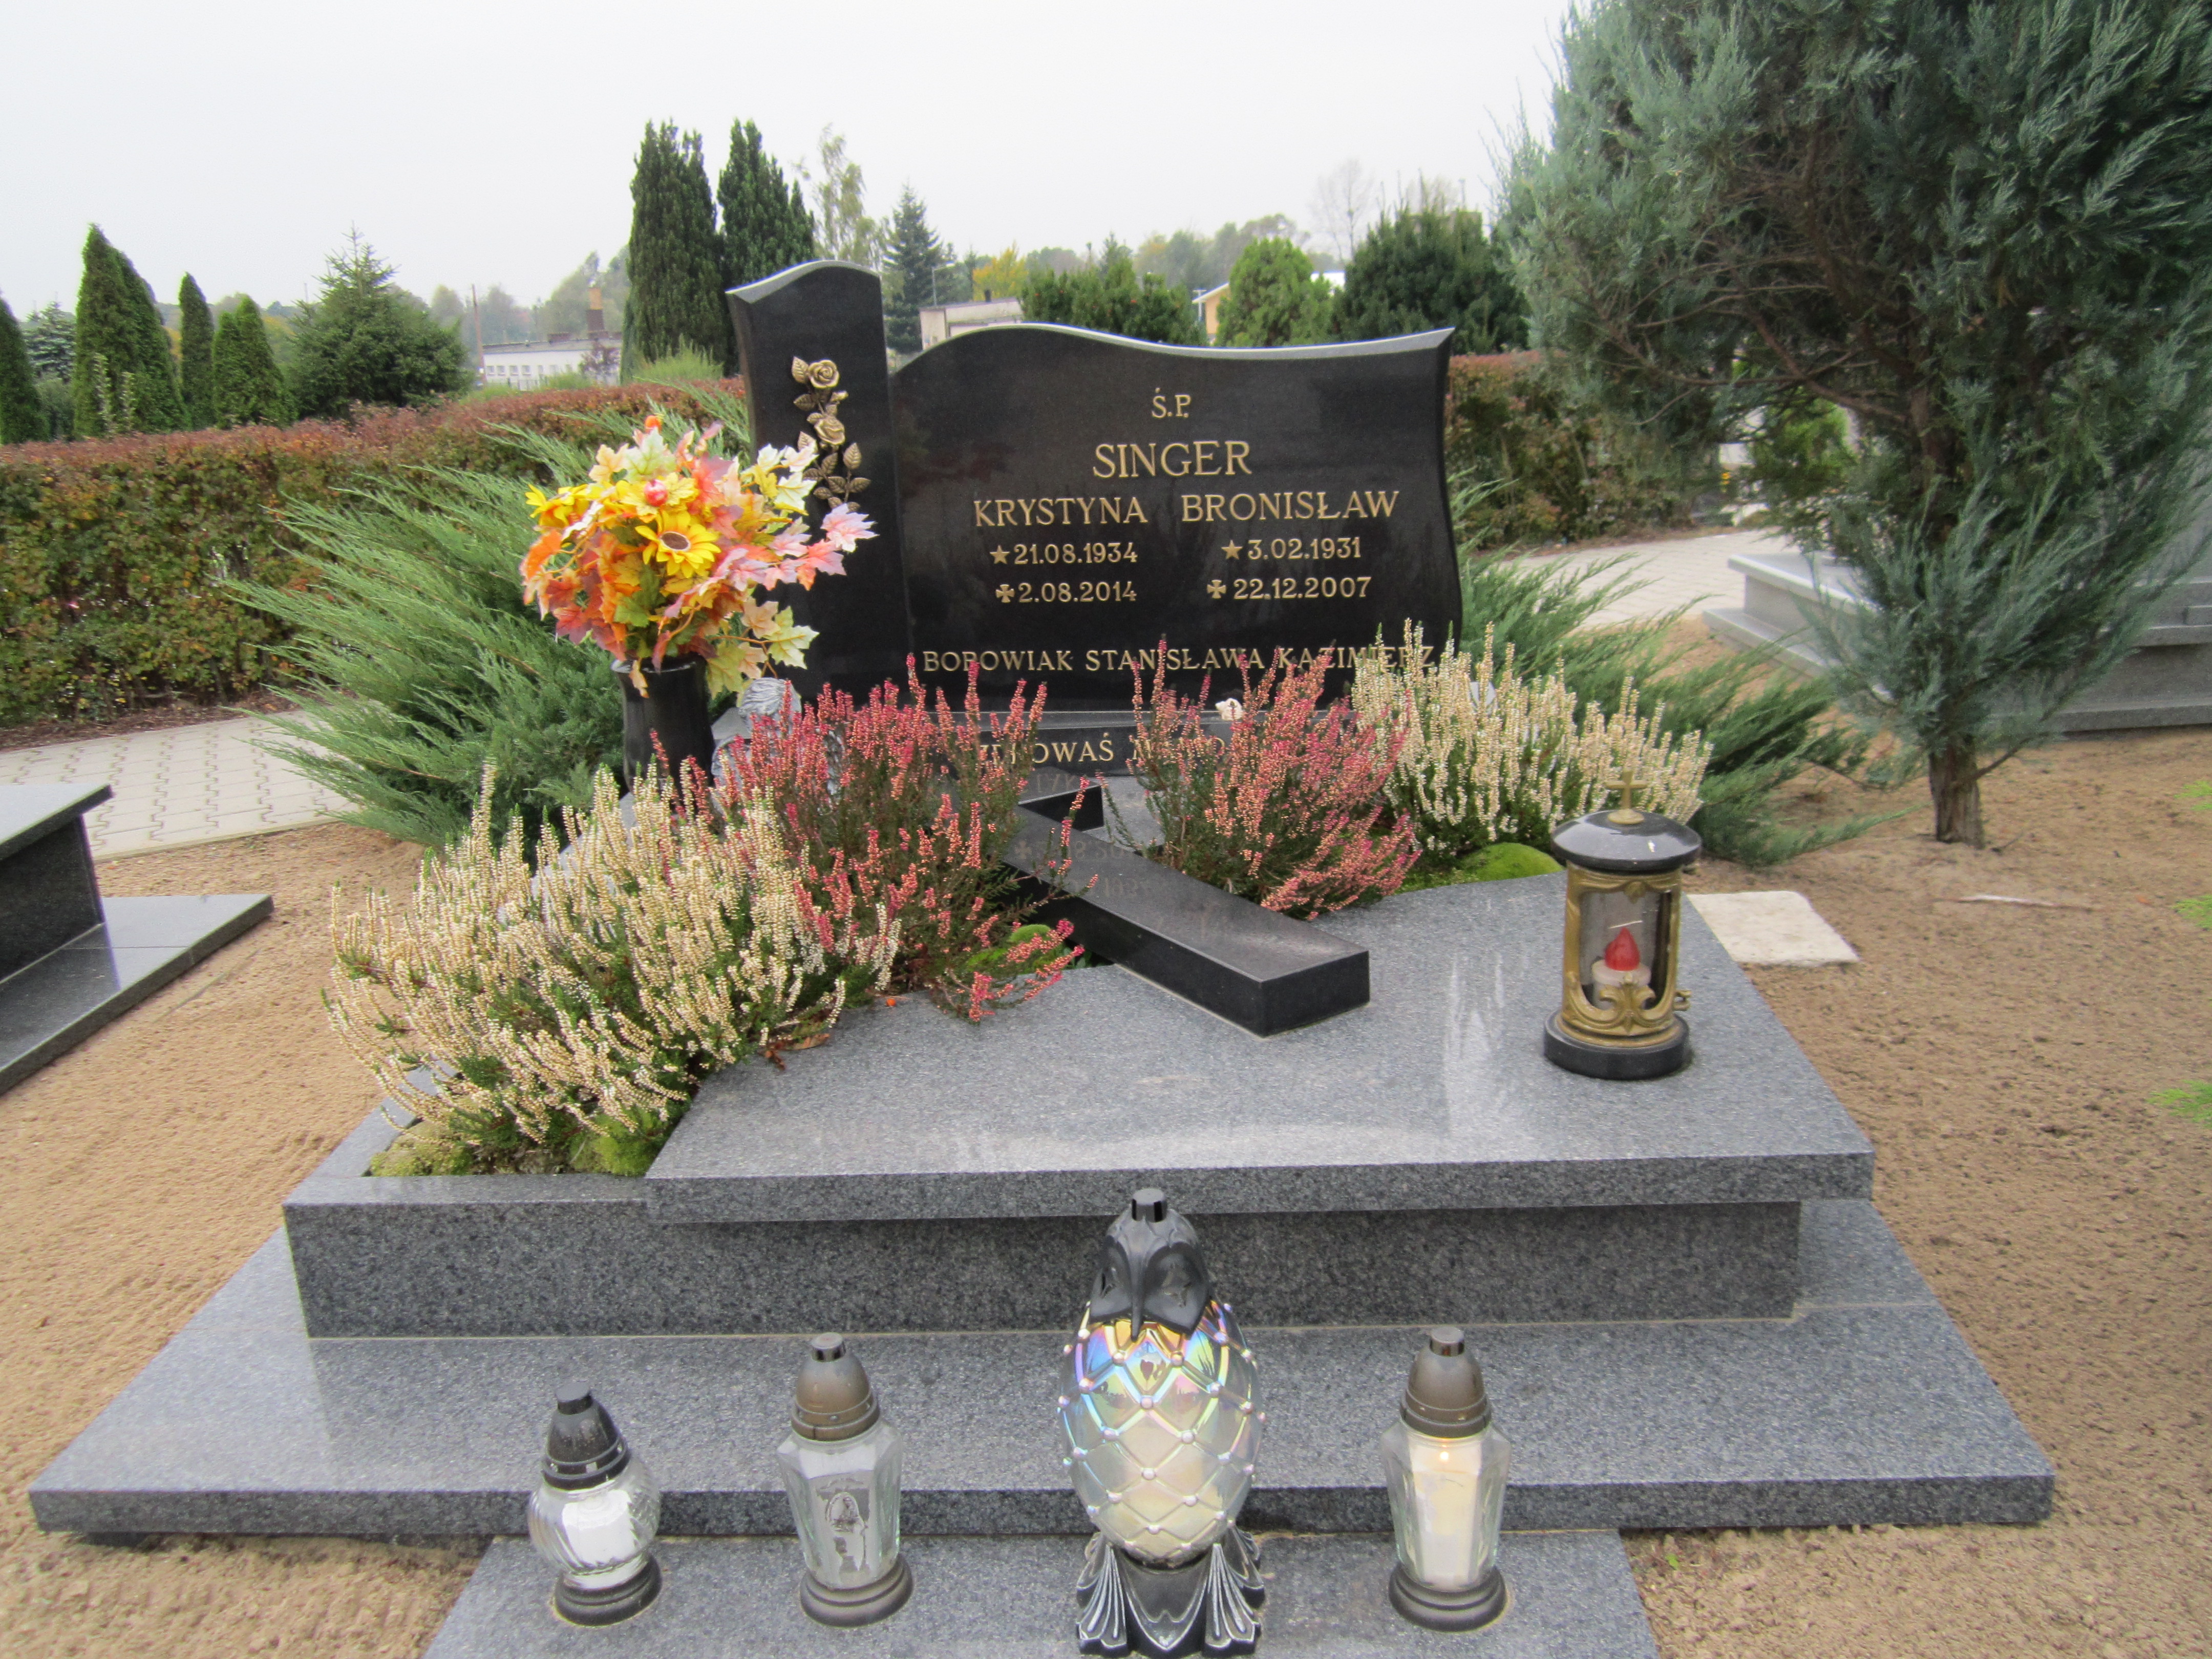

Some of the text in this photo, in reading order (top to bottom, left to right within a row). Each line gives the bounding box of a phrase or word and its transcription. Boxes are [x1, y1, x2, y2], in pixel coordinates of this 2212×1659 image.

[1151, 387, 1192, 419] Ś.P.
[1093, 440, 1252, 479] SINGER
[974, 496, 1148, 527] KRYSTYNA
[1181, 491, 1400, 522] BRONISŁAW
[1013, 542, 1138, 564] 21.08.1934
[1247, 536, 1362, 560] 3.02.1931
[1017, 581, 1137, 603] 2.08.2014
[1233, 576, 1372, 600] 22.12.2007
[922, 650, 1073, 671] BOROWIAK
[1085, 648, 1265, 671] STANSŁAWA
